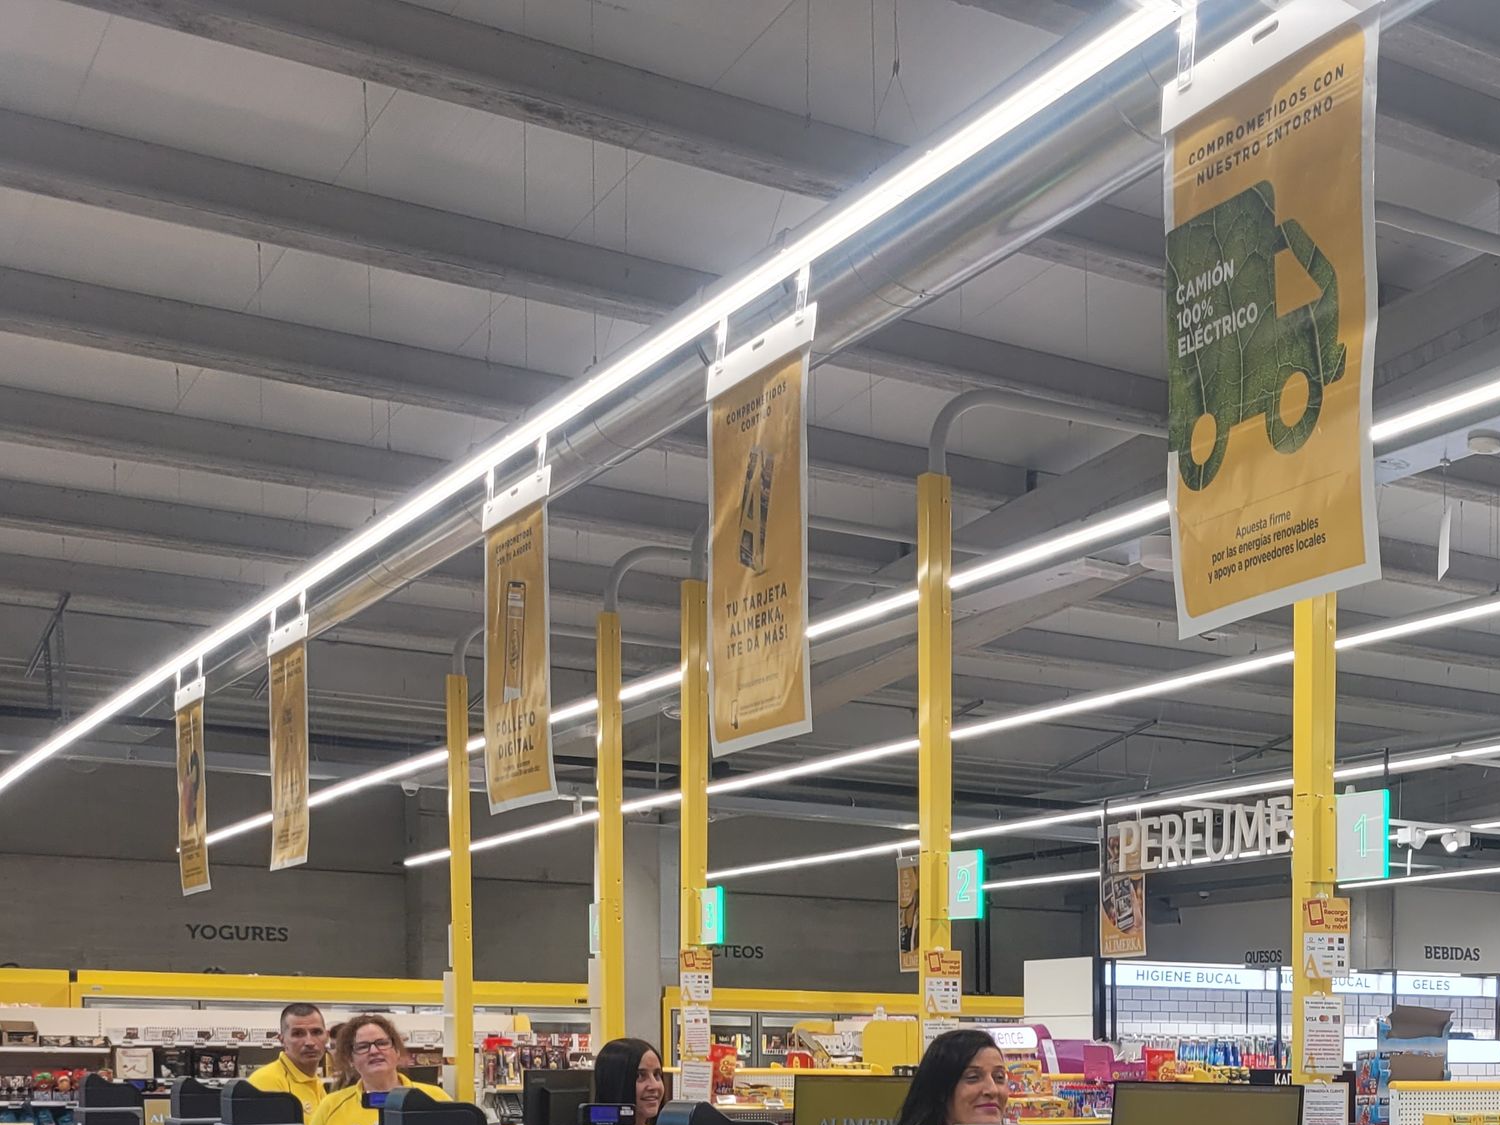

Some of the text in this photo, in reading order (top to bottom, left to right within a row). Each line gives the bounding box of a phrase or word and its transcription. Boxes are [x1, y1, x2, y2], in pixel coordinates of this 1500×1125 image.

[1188, 64, 1344, 166] COMPROMETIDOS CON
[1196, 95, 1334, 187] NUESTRO ENTORNO
[1176, 258, 1234, 305] CAMIÓN
[1176, 296, 1213, 332] 100%
[1177, 302, 1258, 358] ELÉCTRICO
[741, 405, 772, 432] CONTO
[1235, 510, 1291, 539] Apuesta firme
[1208, 532, 1326, 584] y apoyo a proveedores locales
[1211, 517, 1319, 566] por las energías renovables
[726, 582, 787, 618] TU TARJETA
[730, 606, 785, 639] ALIMERKA,
[747, 634, 760, 653] DA
[763, 623, 788, 647] MÁS!
[496, 710, 535, 737] FOLLETO
[498, 734, 534, 761] DIGITAL
[1353, 813, 1367, 858] 1
[956, 867, 971, 902] 2
[185, 923, 289, 942] YOGURES
[1245, 950, 1282, 965] QUESOS
[1424, 945, 1480, 961] BEBIDAS
[1135, 969, 1241, 985] HIGIENE BUCAL
[1412, 979, 1450, 991] GELES
